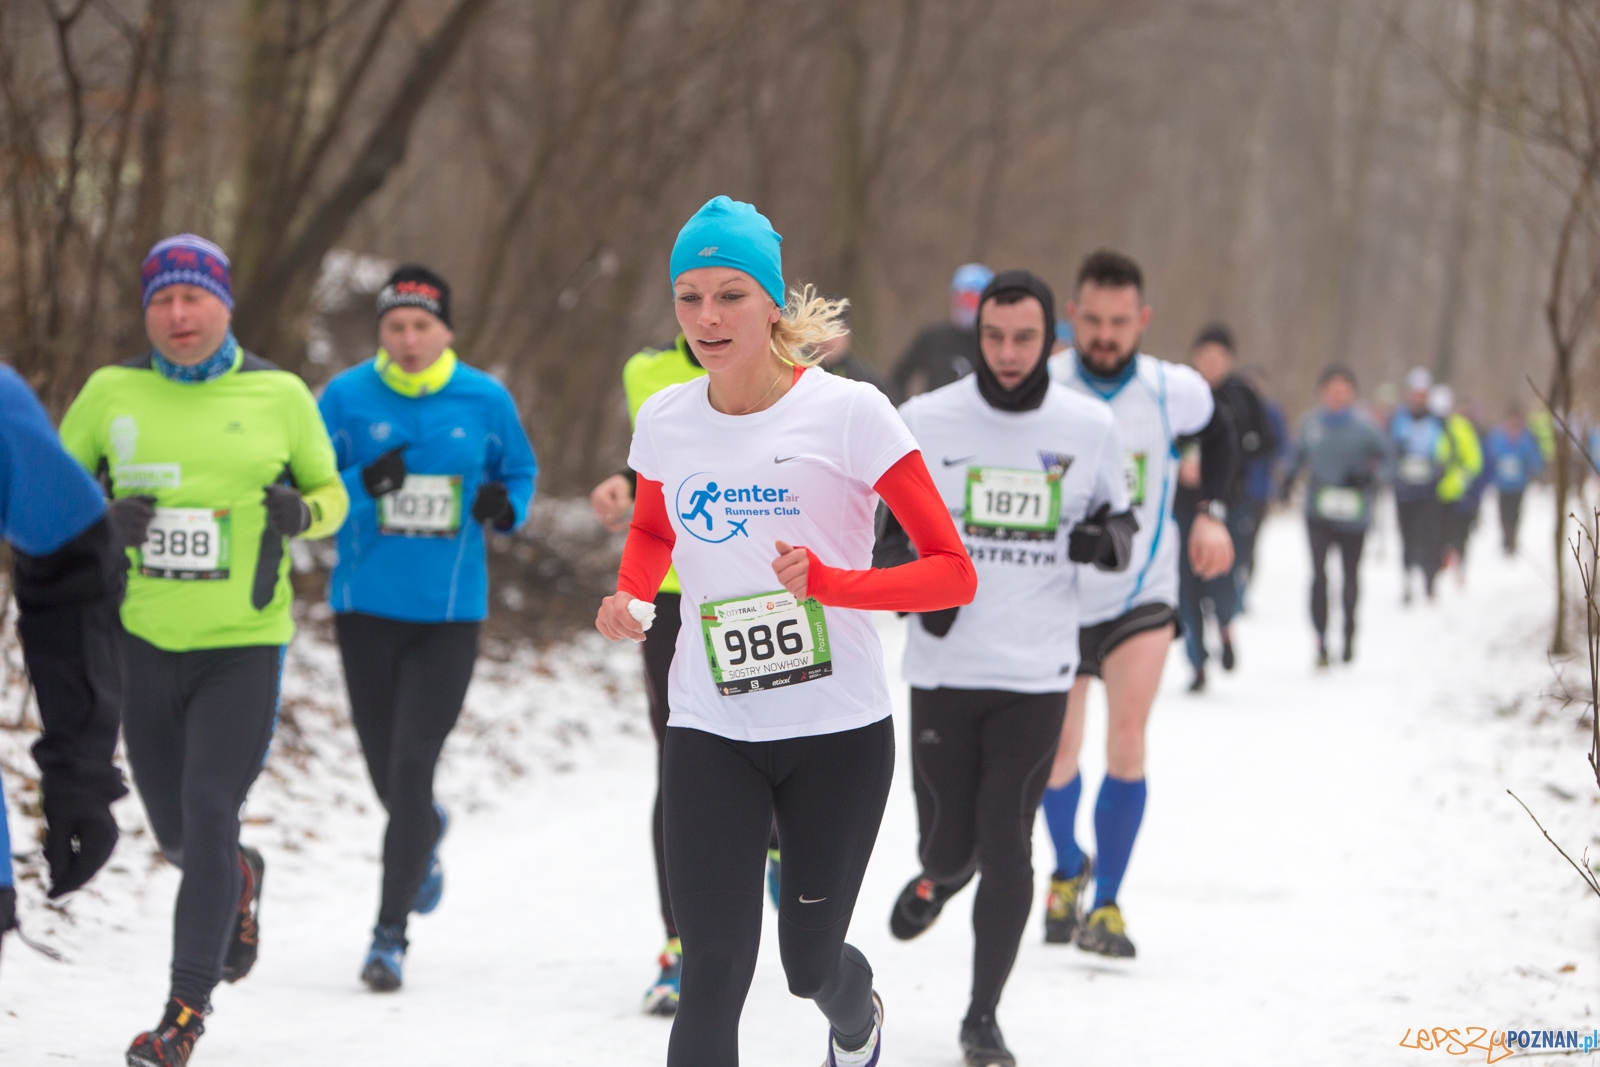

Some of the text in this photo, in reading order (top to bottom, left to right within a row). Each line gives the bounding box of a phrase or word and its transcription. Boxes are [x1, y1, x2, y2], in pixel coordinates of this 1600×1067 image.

[391, 493, 450, 518] 1037
[723, 484, 799, 502] enter air
[984, 489, 1042, 516] 1871
[724, 507, 801, 516] Runners Club
[149, 528, 209, 556] 388
[724, 618, 803, 666] 986
[814, 621, 826, 653] Poznań
[728, 656, 809, 679] SIOSTRY NOWHOW
